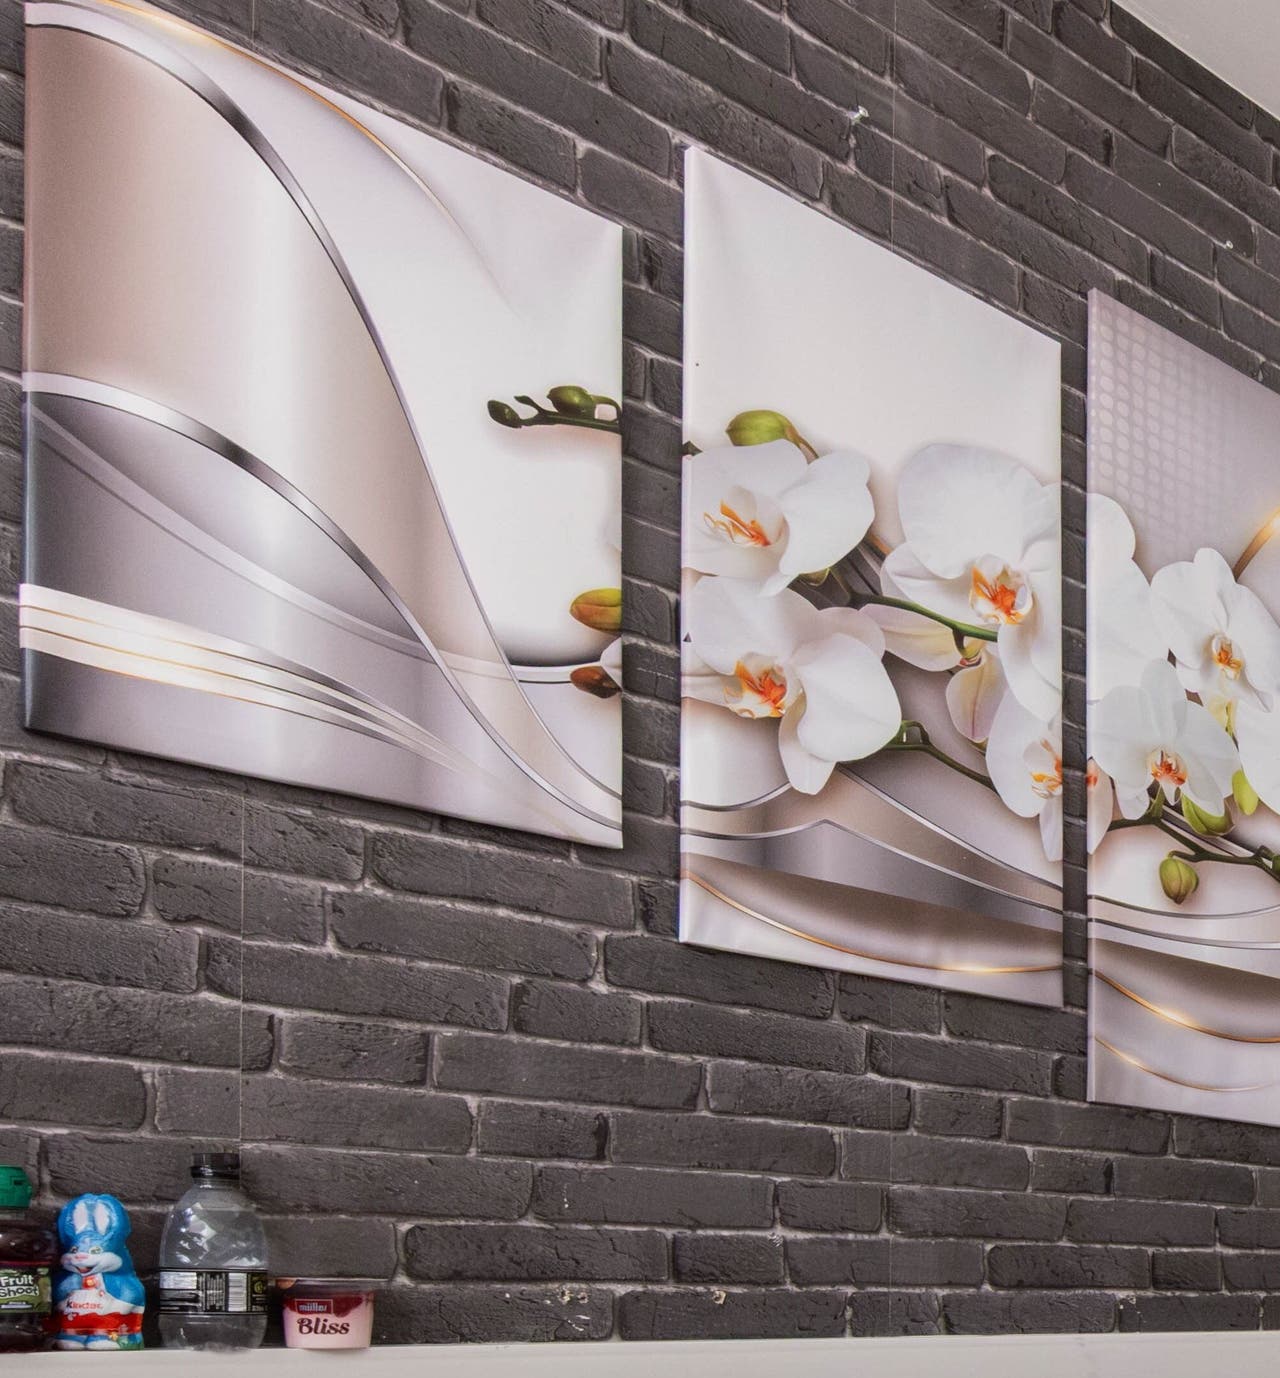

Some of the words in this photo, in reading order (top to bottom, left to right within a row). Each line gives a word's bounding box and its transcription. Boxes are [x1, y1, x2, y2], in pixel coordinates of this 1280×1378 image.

[1, 1274, 35, 1287] Fruit
[0, 1286, 39, 1298] Shoot
[297, 1317, 351, 1335] Bliss
